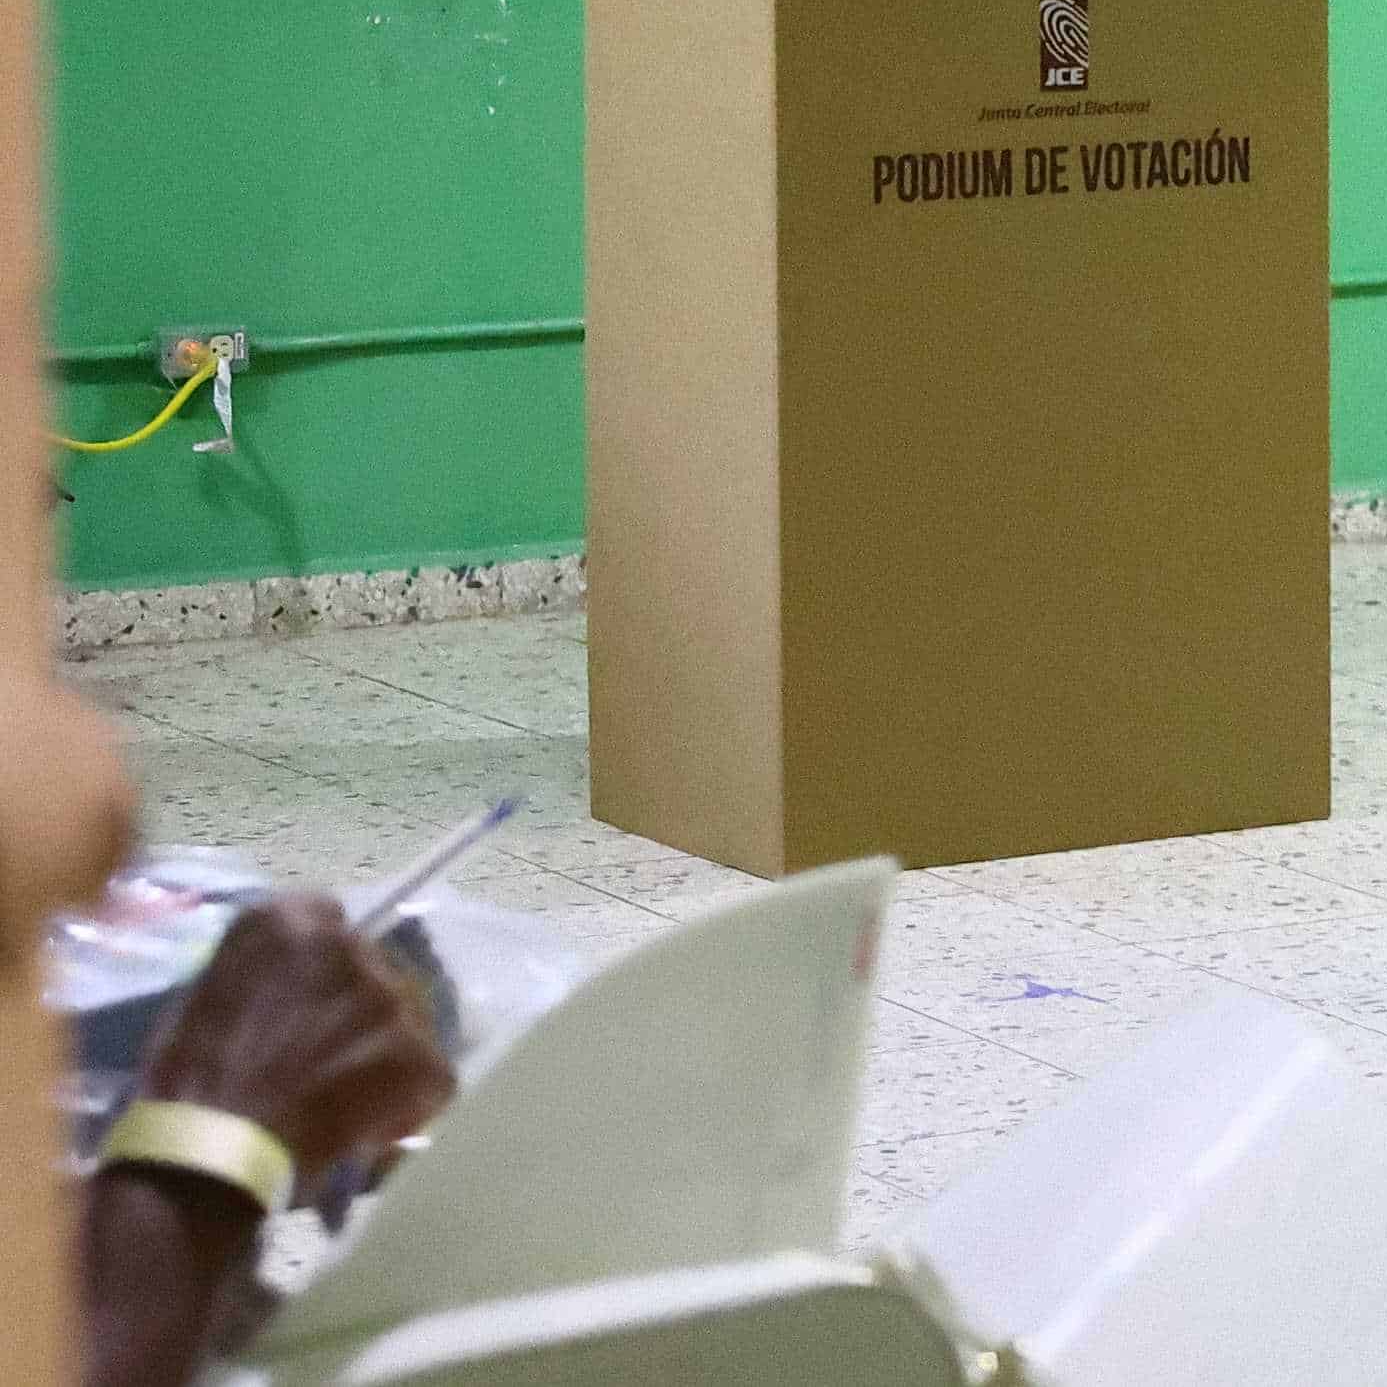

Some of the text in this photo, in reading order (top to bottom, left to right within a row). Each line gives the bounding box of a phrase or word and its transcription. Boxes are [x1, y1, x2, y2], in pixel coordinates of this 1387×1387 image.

[1045, 68, 1085, 87] JCE
[872, 128, 1250, 204] PODIUM DE VOTACIÓN
